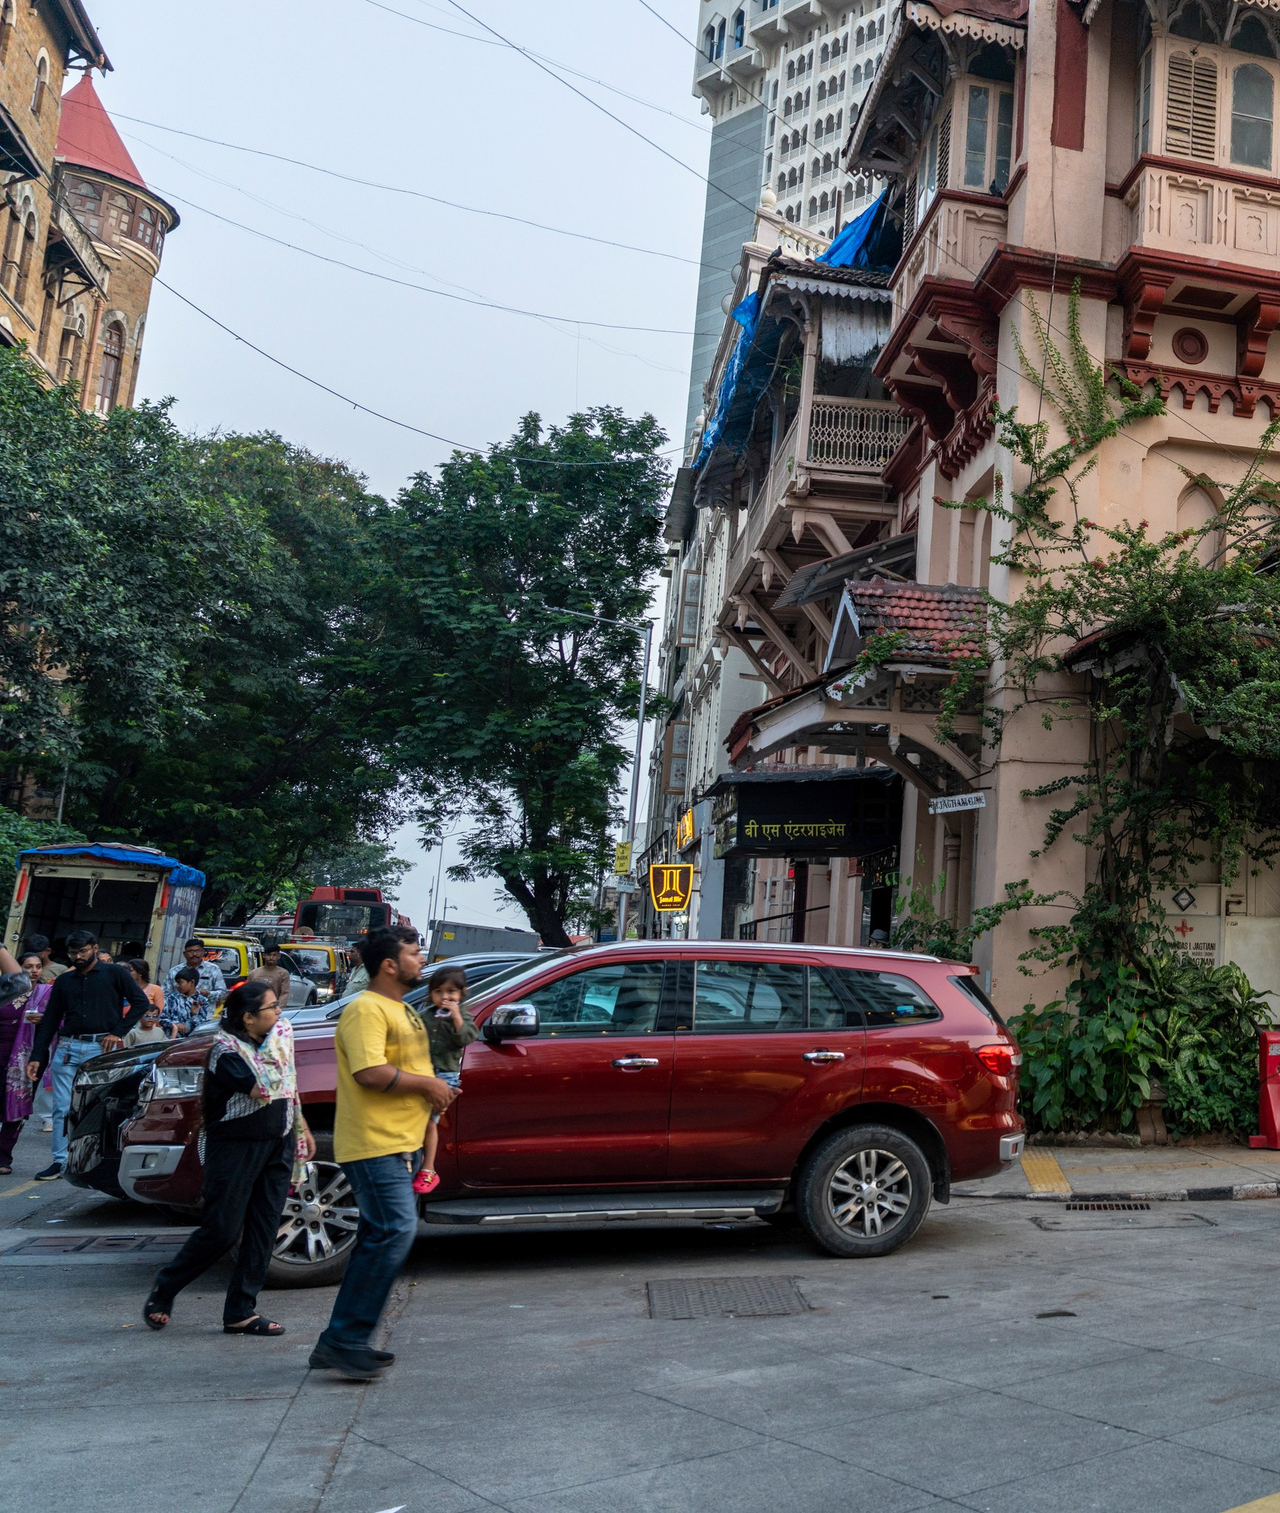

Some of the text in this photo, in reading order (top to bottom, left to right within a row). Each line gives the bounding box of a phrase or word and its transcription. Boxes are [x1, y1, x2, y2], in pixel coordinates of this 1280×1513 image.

[745, 819, 846, 841] बी एस एंटरप्राइजेस
[1192, 942, 1216, 951] JAGTIANI
